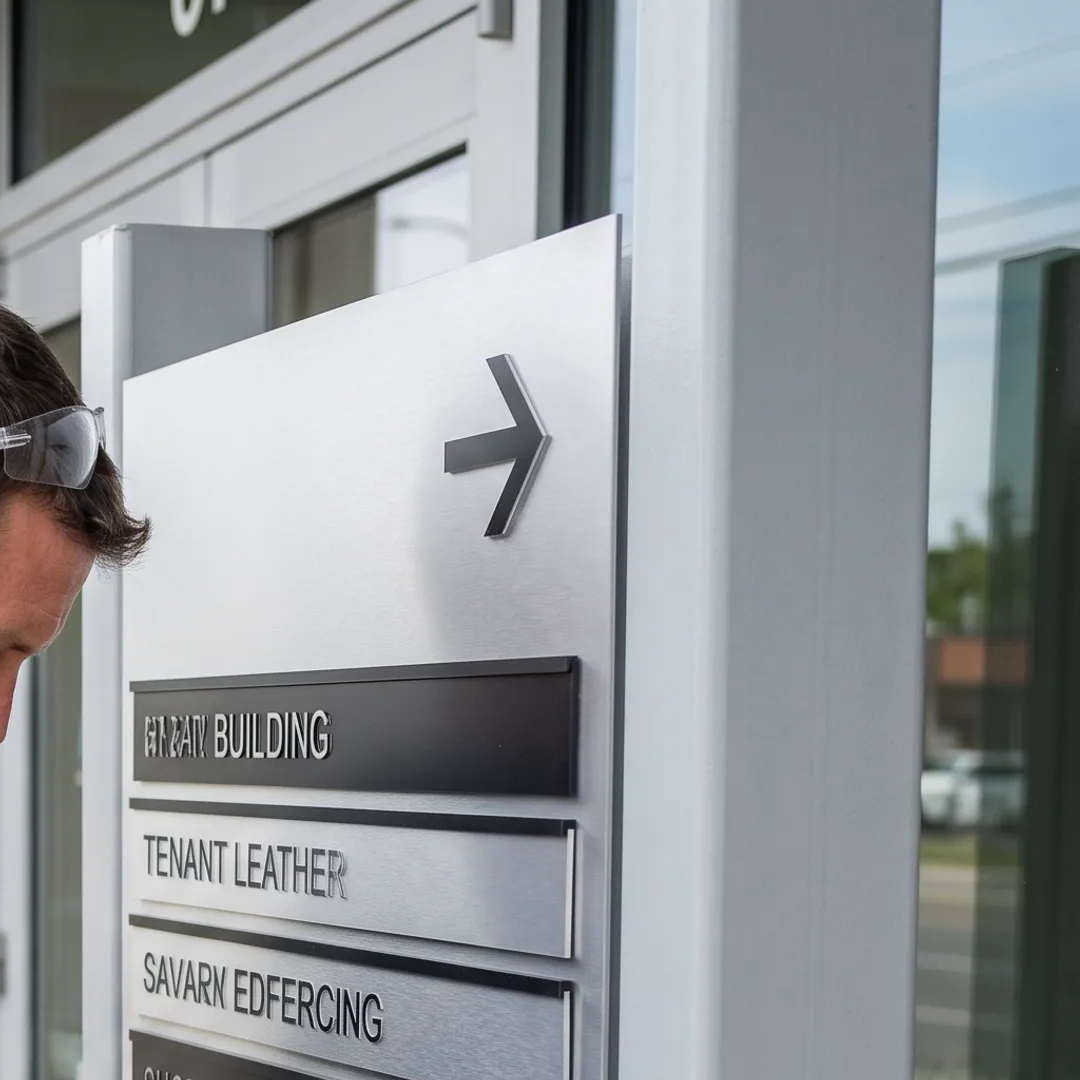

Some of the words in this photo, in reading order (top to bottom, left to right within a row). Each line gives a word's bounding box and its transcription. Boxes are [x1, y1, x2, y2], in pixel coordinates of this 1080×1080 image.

[214, 709, 331, 760] BUILDING
[143, 834, 227, 884] TENANT
[234, 841, 347, 899] LEATHER
[234, 969, 384, 1043] EDFERCING
